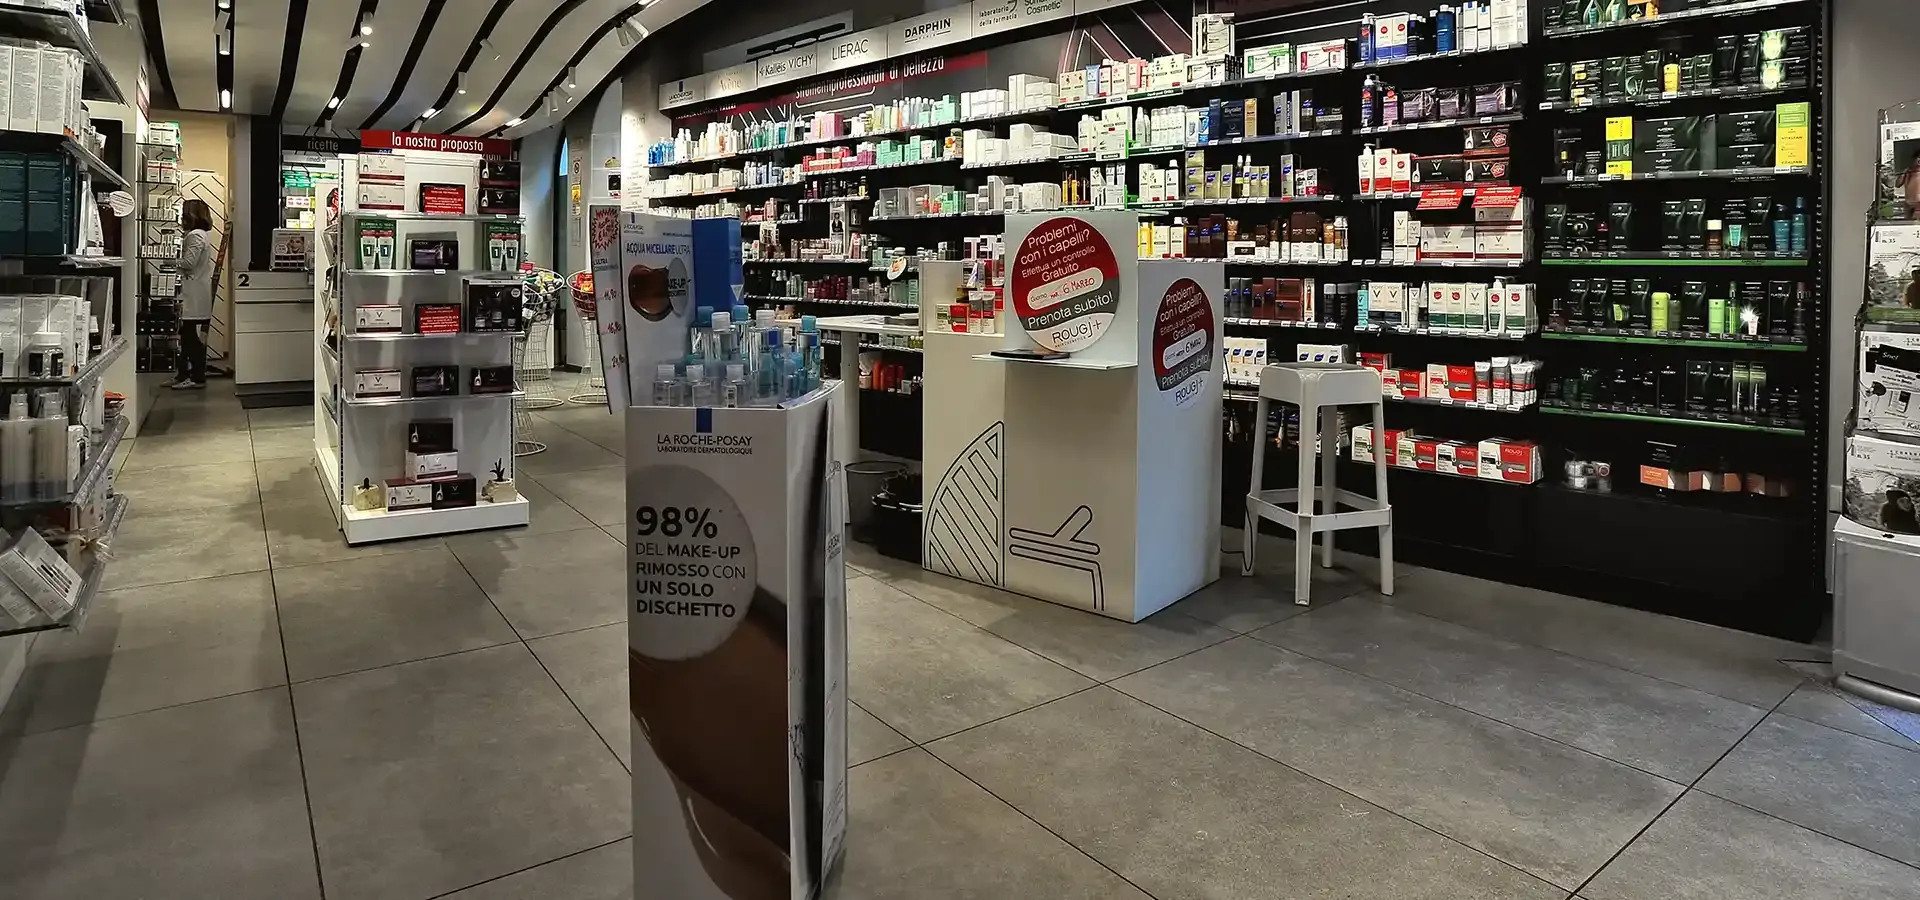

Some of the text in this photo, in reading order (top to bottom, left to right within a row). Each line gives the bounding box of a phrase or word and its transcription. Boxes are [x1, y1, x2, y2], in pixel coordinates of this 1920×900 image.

[979, 6, 1009, 17] laboratorio
[1026, 1, 1061, 15] Cosmetic
[904, 18, 951, 38] DARPHIN
[979, 13, 1017, 27] della farmacia
[831, 39, 869, 60] LIERAC
[788, 54, 814, 69] VICHY
[831, 67, 885, 96] professionali
[889, 63, 898, 80] di
[903, 55, 944, 78] bellezza
[307, 138, 339, 151] ricette
[391, 132, 484, 152] la nostra proposta
[1028, 220, 1077, 249] Problemi
[626, 243, 691, 256] ACQUA MICELLARE ULTRA
[1020, 228, 1090, 265] con i capelli?
[1021, 245, 1096, 278] Effettua un controllo
[237, 273, 250, 287] 2
[1041, 262, 1079, 282] Gratuito
[1030, 292, 1048, 302] Giorno
[1062, 283, 1070, 294] 6
[1070, 277, 1095, 292] MARZO
[1165, 282, 1195, 306] Problemi
[1027, 290, 1114, 329] Prenota subito!
[1160, 309, 1174, 322] con
[1178, 292, 1202, 313] capelli?
[1172, 323, 1195, 340] Gratuito
[1179, 318, 1185, 327] un
[1161, 366, 1189, 389] Prenota
[657, 434, 753, 446] LA ROCHE-POSAY
[657, 445, 753, 455] LABORATOIRE DERMATOLOGIQUE
[635, 505, 719, 539] 98%
[635, 542, 741, 559] DEL MAKE-UP
[636, 561, 746, 579] RIMOSSO CON
[636, 580, 714, 598] UN SOLO
[636, 599, 736, 618] DISCHETTO
